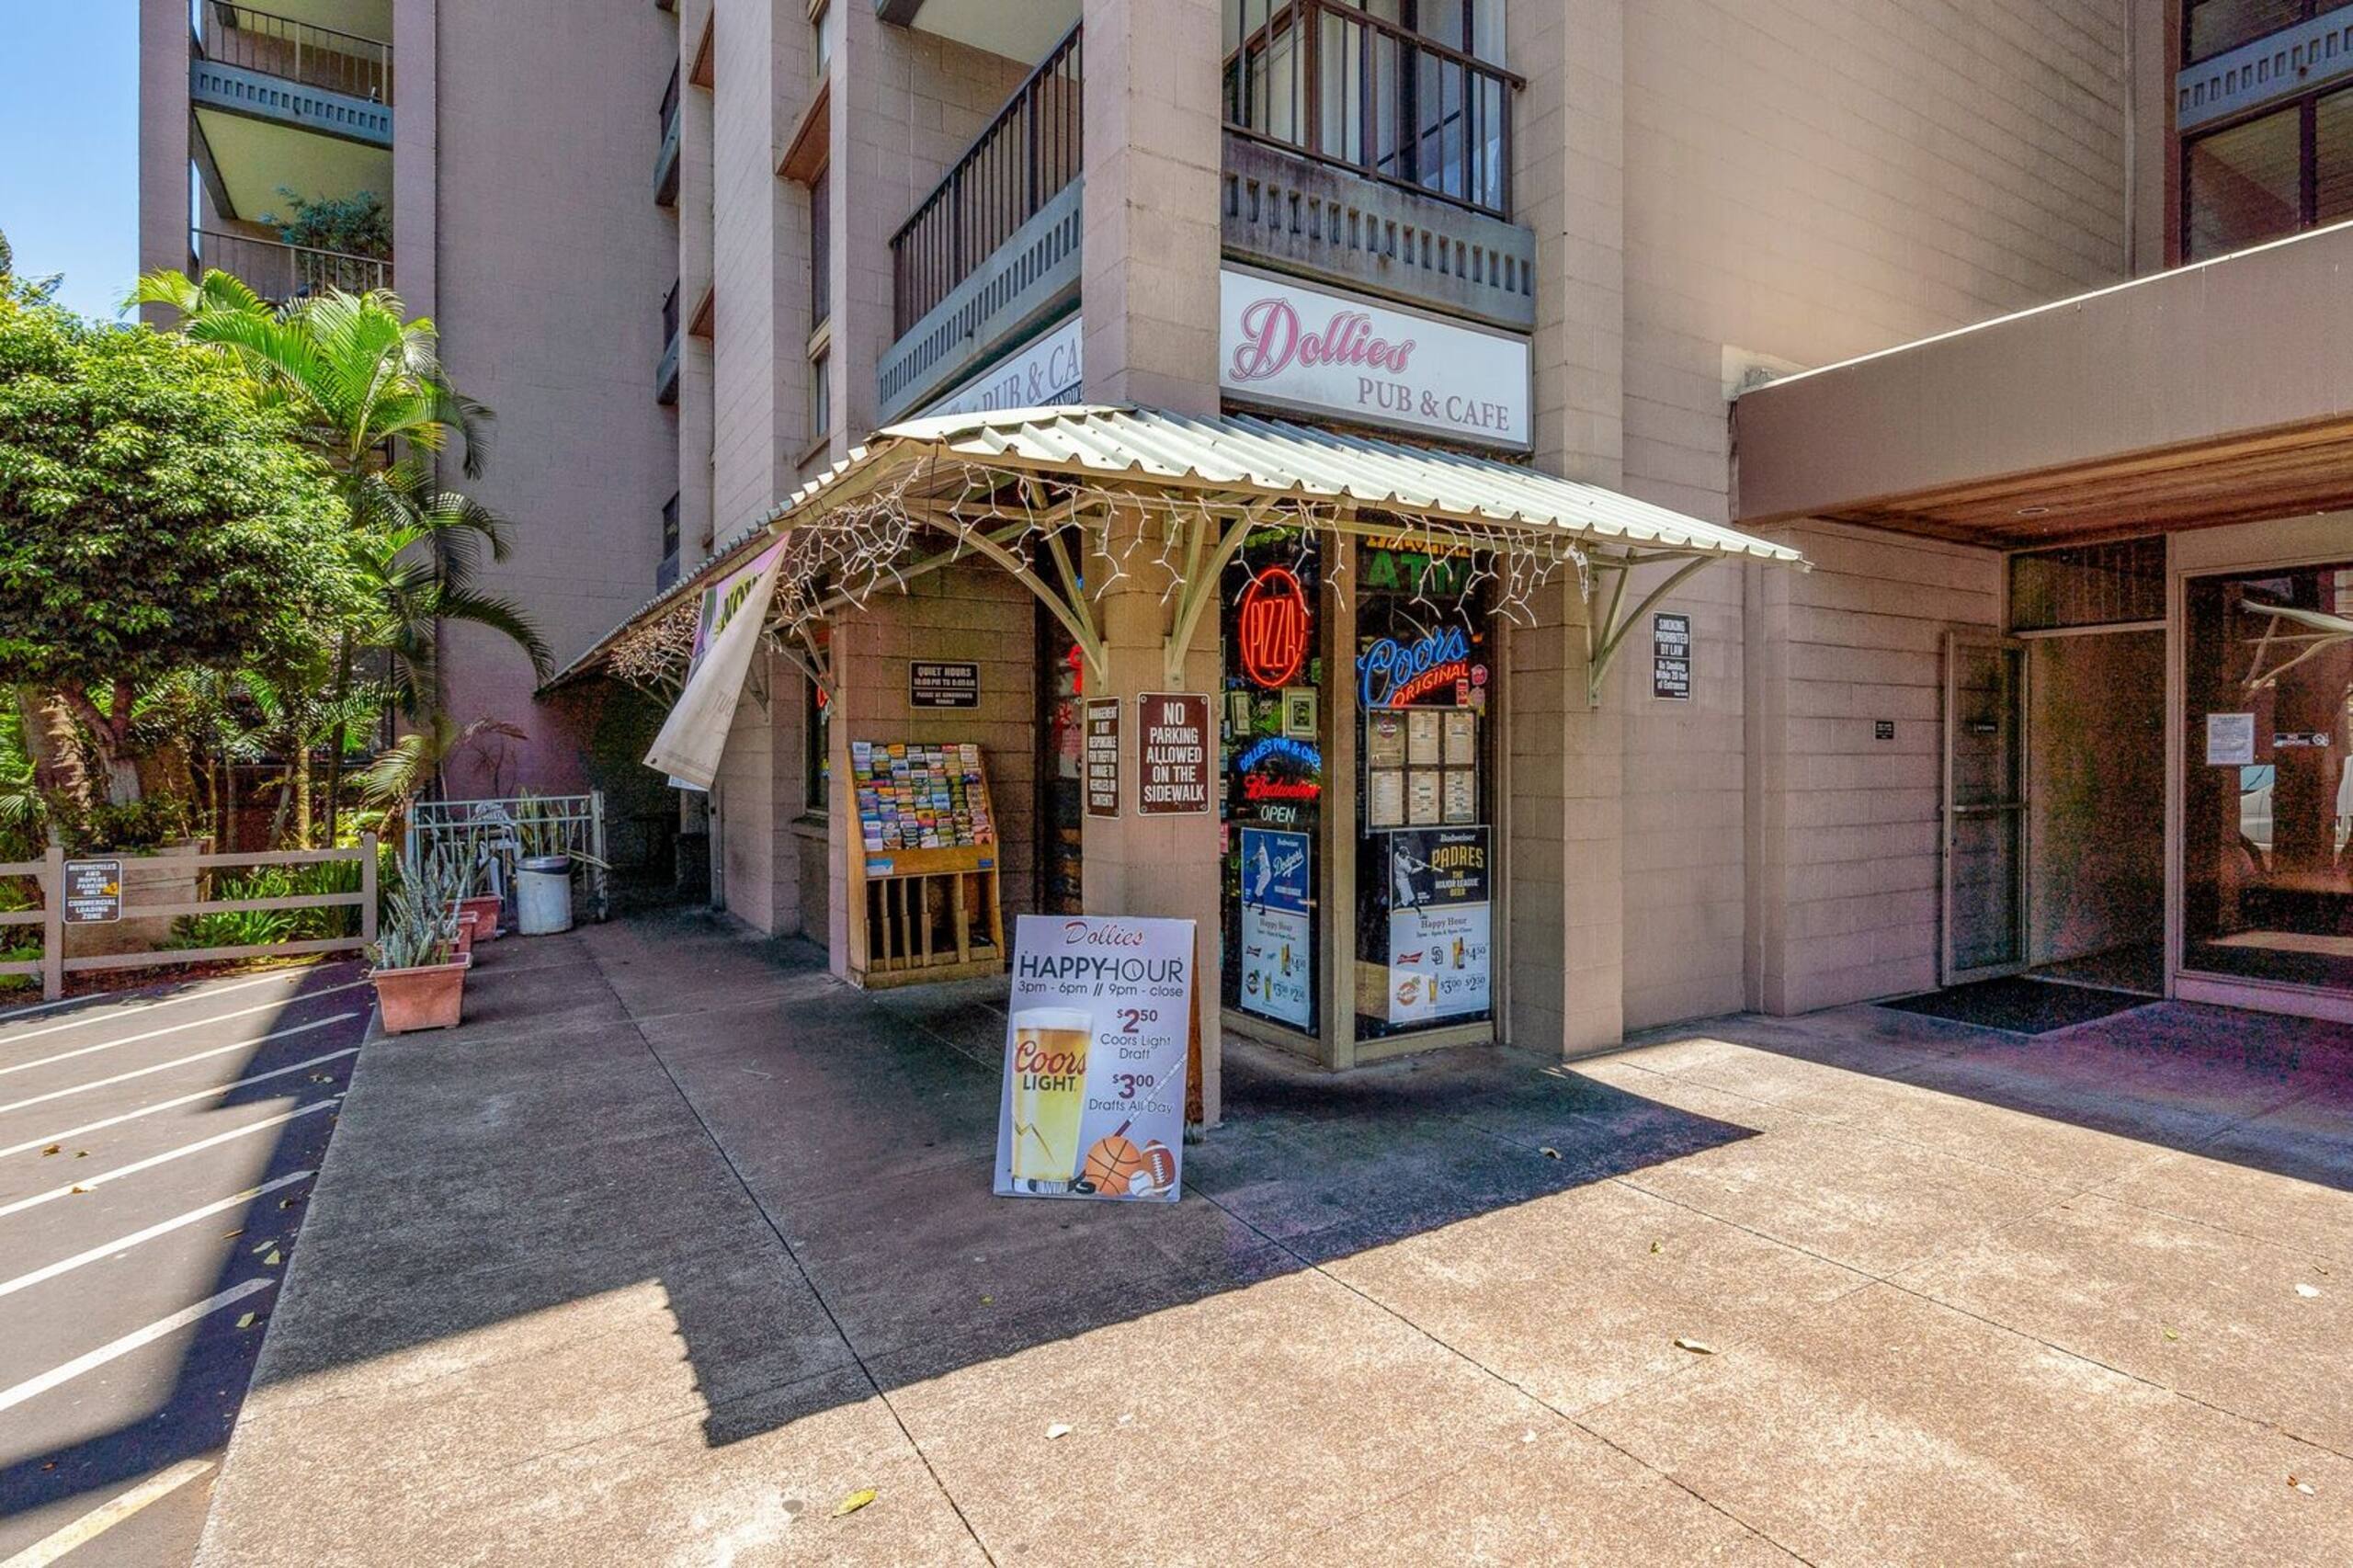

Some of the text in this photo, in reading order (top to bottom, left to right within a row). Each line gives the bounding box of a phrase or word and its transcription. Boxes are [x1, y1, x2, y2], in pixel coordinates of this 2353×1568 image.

[1229, 298, 1415, 382] Dollies
[1049, 337, 1081, 390] CA
[1358, 376, 1509, 432] PUB & CAFE
[1368, 551, 1471, 595] ATM
[1251, 598, 1296, 667] PIZZA
[1357, 625, 1470, 707] Coors
[1392, 661, 1470, 708] ORIGINAL
[1164, 702, 1185, 725] NO
[1150, 727, 1199, 744] PARKING
[1146, 746, 1202, 764] ALLOWED
[1153, 766, 1196, 782] ON THE
[1144, 785, 1205, 801] SIDEWALK
[1260, 804, 1296, 823] OPEN
[1431, 846, 1483, 871] PADRES
[1421, 917, 1467, 929] Happy Hour
[1065, 922, 1142, 946] Dollies
[1017, 980, 1046, 994] 3pm
[1059, 982, 1087, 995] 6pm
[1108, 983, 1137, 997] 9pm
[1150, 986, 1183, 997] close
[1100, 1033, 1171, 1049] Coors Light
[1015, 1040, 1086, 1075] Coors
[1119, 1048, 1150, 1059] Draft
[1023, 1074, 1075, 1092] LIGHT
[1089, 1098, 1125, 1111] Drafts
[1147, 1101, 1172, 1113] Day
